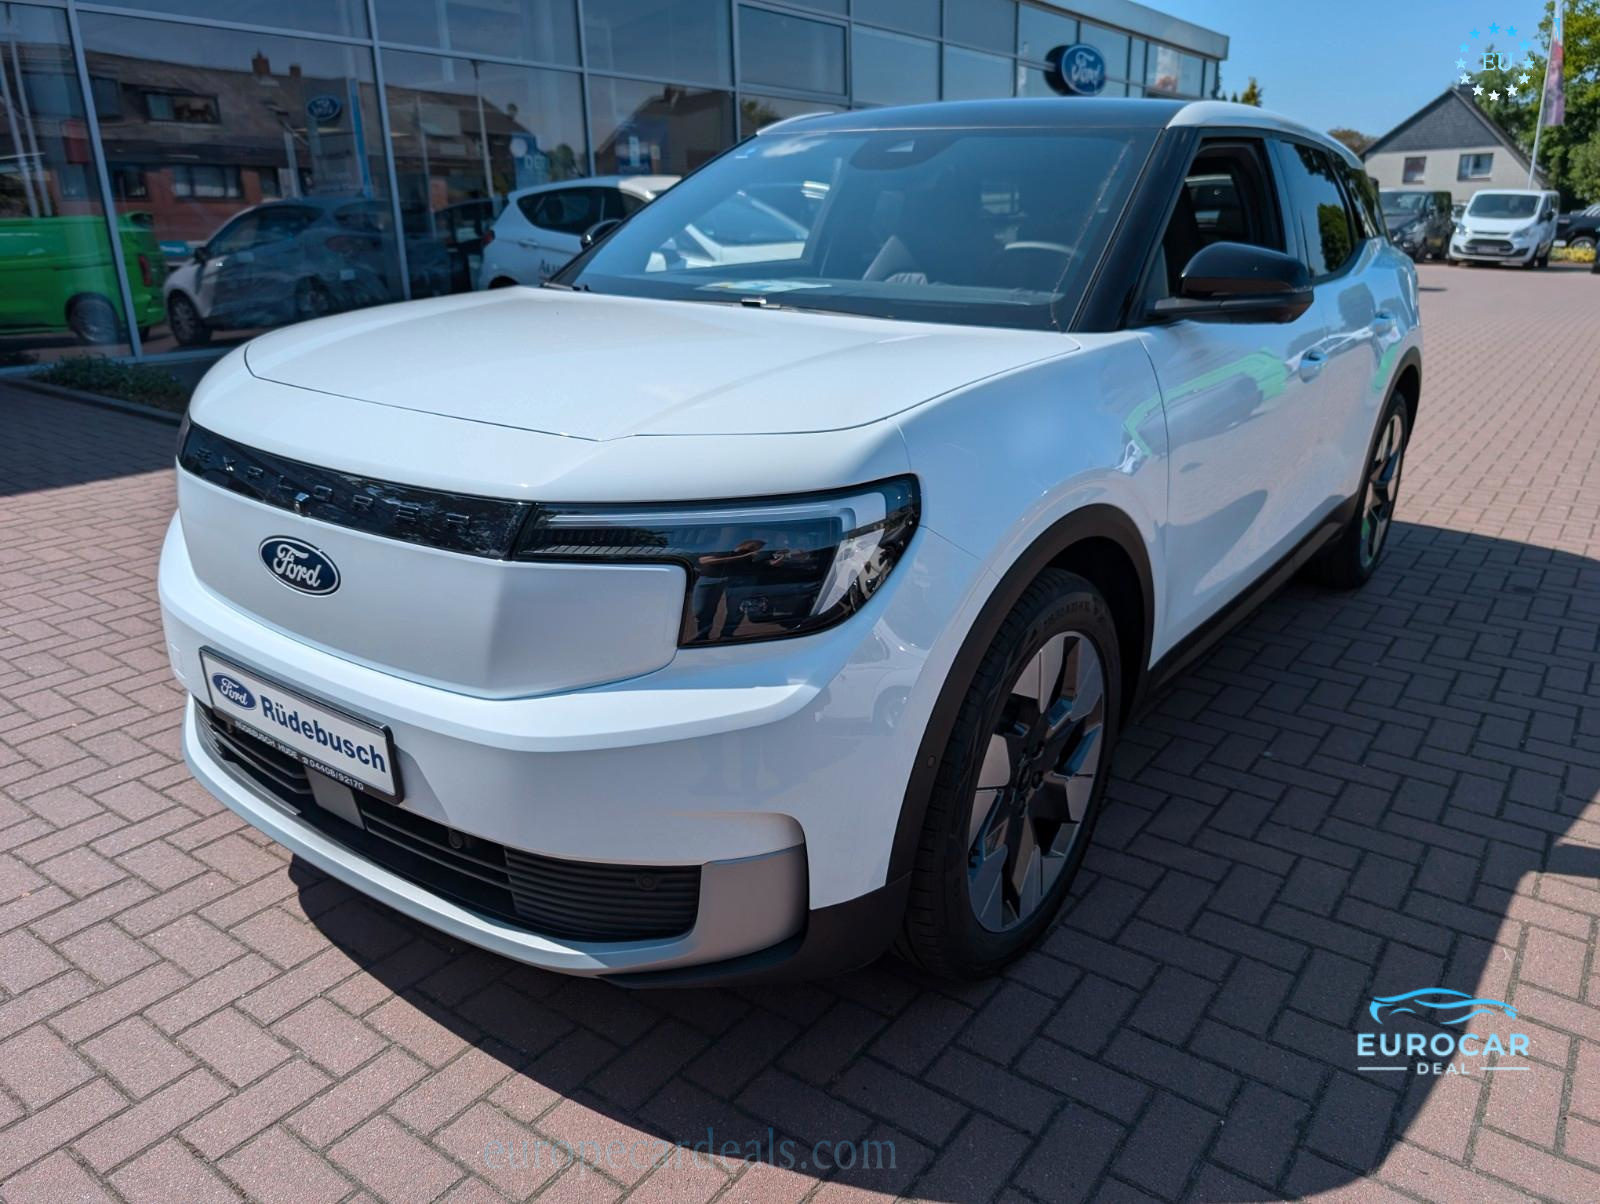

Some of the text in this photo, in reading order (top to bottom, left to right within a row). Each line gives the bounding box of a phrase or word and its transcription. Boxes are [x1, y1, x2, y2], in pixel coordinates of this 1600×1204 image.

[1071, 50, 1102, 85] Ford
[196, 447, 471, 528] EXPLORER
[271, 540, 325, 588] Ford
[221, 676, 386, 773] Ford Rüdebusch
